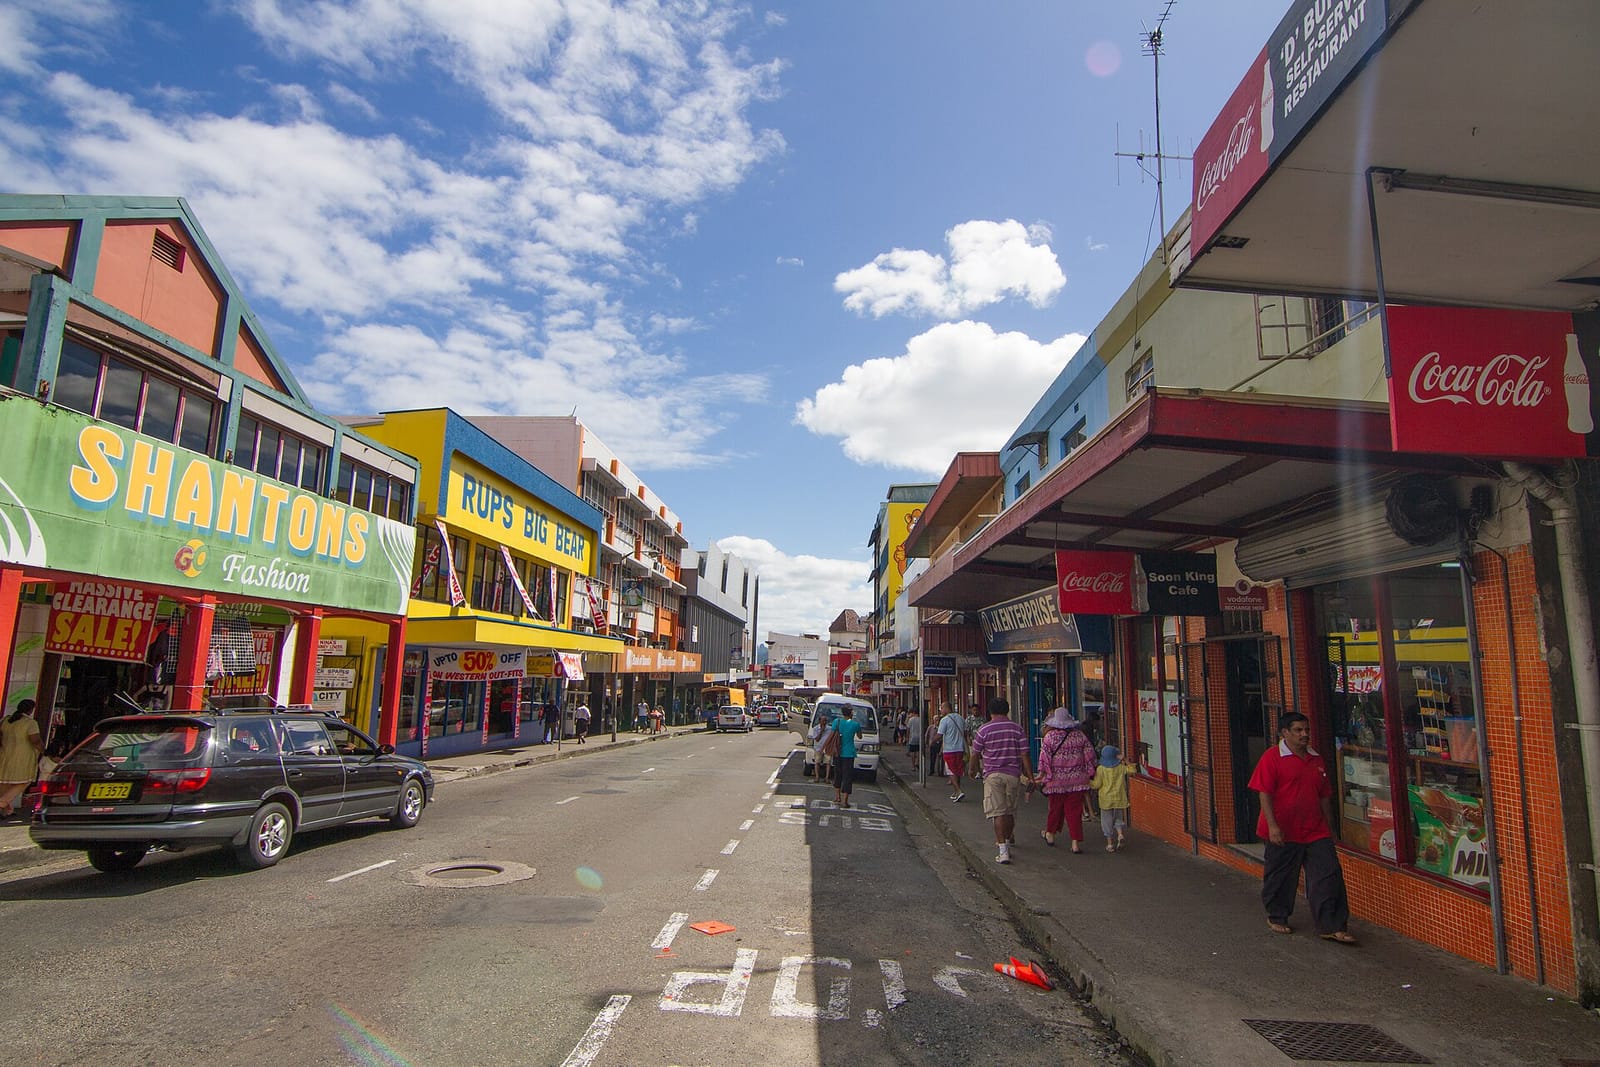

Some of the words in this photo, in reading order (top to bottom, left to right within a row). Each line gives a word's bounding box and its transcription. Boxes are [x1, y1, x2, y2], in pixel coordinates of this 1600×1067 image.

[1286, 0, 1361, 89] SELF-SERV
[1284, 0, 1367, 118] RESTAURANT
[1408, 352, 1551, 407] Coca-Cola
[69, 425, 369, 565] SHANTONS
[461, 473, 514, 529] RUPS
[524, 506, 547, 545] BIG
[555, 522, 585, 562] BEAR
[223, 551, 310, 594] Fashion
[1062, 571, 1126, 593] Coca-Cola
[1148, 572, 1181, 582] Soon
[1185, 571, 1215, 584] King
[69, 581, 143, 600] MASSIVE
[1168, 585, 1198, 595] Cafe
[1227, 595, 1263, 603] vodafone
[52, 592, 154, 620] CLEARANCE
[52, 612, 142, 651] SALE!
[463, 651, 495, 672] 50%
[500, 652, 522, 664] OFF
[433, 671, 443, 679] ON
[446, 671, 487, 681] WESTERN
[489, 669, 524, 679] OUT-FITS
[319, 691, 341, 700] CITY
[91, 786, 104, 798] LT
[105, 785, 129, 797] 3572
